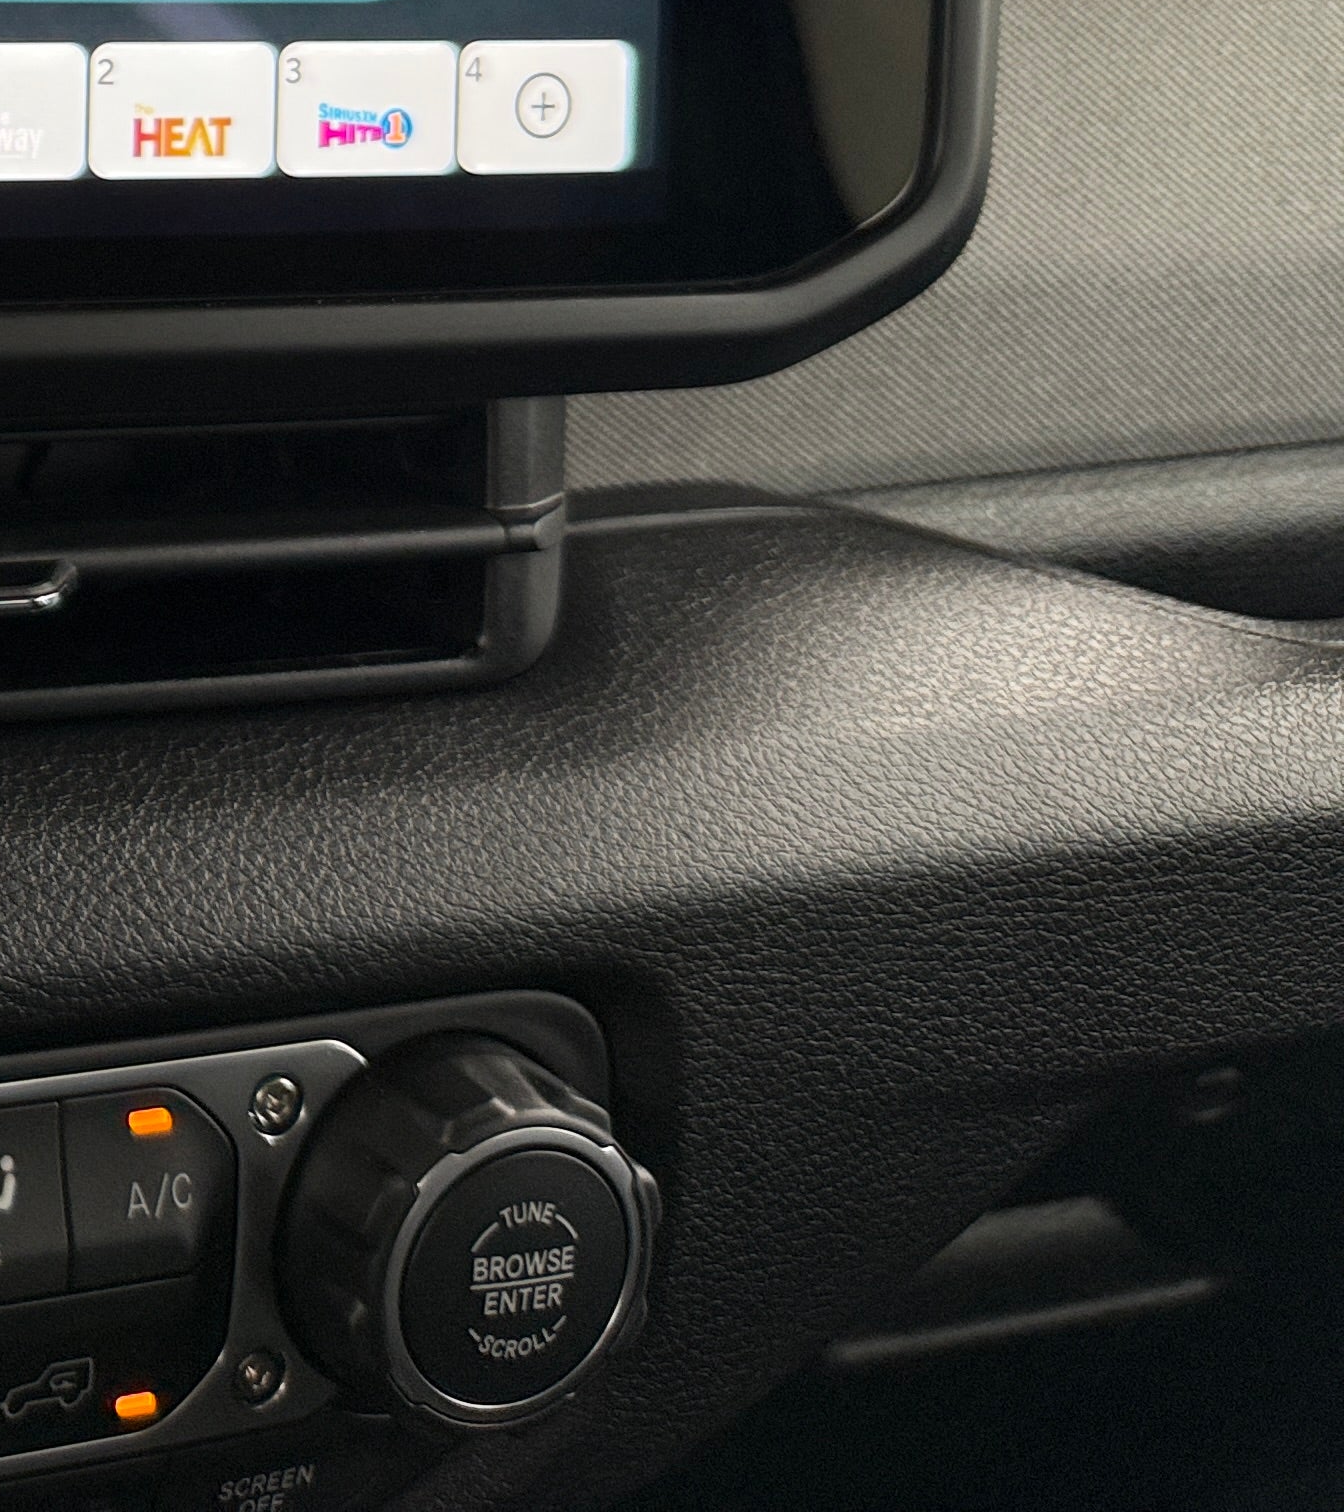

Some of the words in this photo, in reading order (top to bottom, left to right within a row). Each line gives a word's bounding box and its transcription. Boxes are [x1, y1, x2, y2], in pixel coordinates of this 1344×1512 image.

[97, 59, 115, 86] 2
[285, 57, 303, 85] 3
[464, 56, 483, 83] 4
[132, 117, 232, 158] HEAT
[126, 1171, 194, 1221] A/C
[499, 1201, 557, 1229] TUNE
[472, 1244, 575, 1283] BROWSE
[483, 1283, 563, 1316] ENTER
[478, 1328, 557, 1360] SCROLL
[218, 1462, 315, 1502] SCREEN
[238, 1492, 287, 1512] OFF
